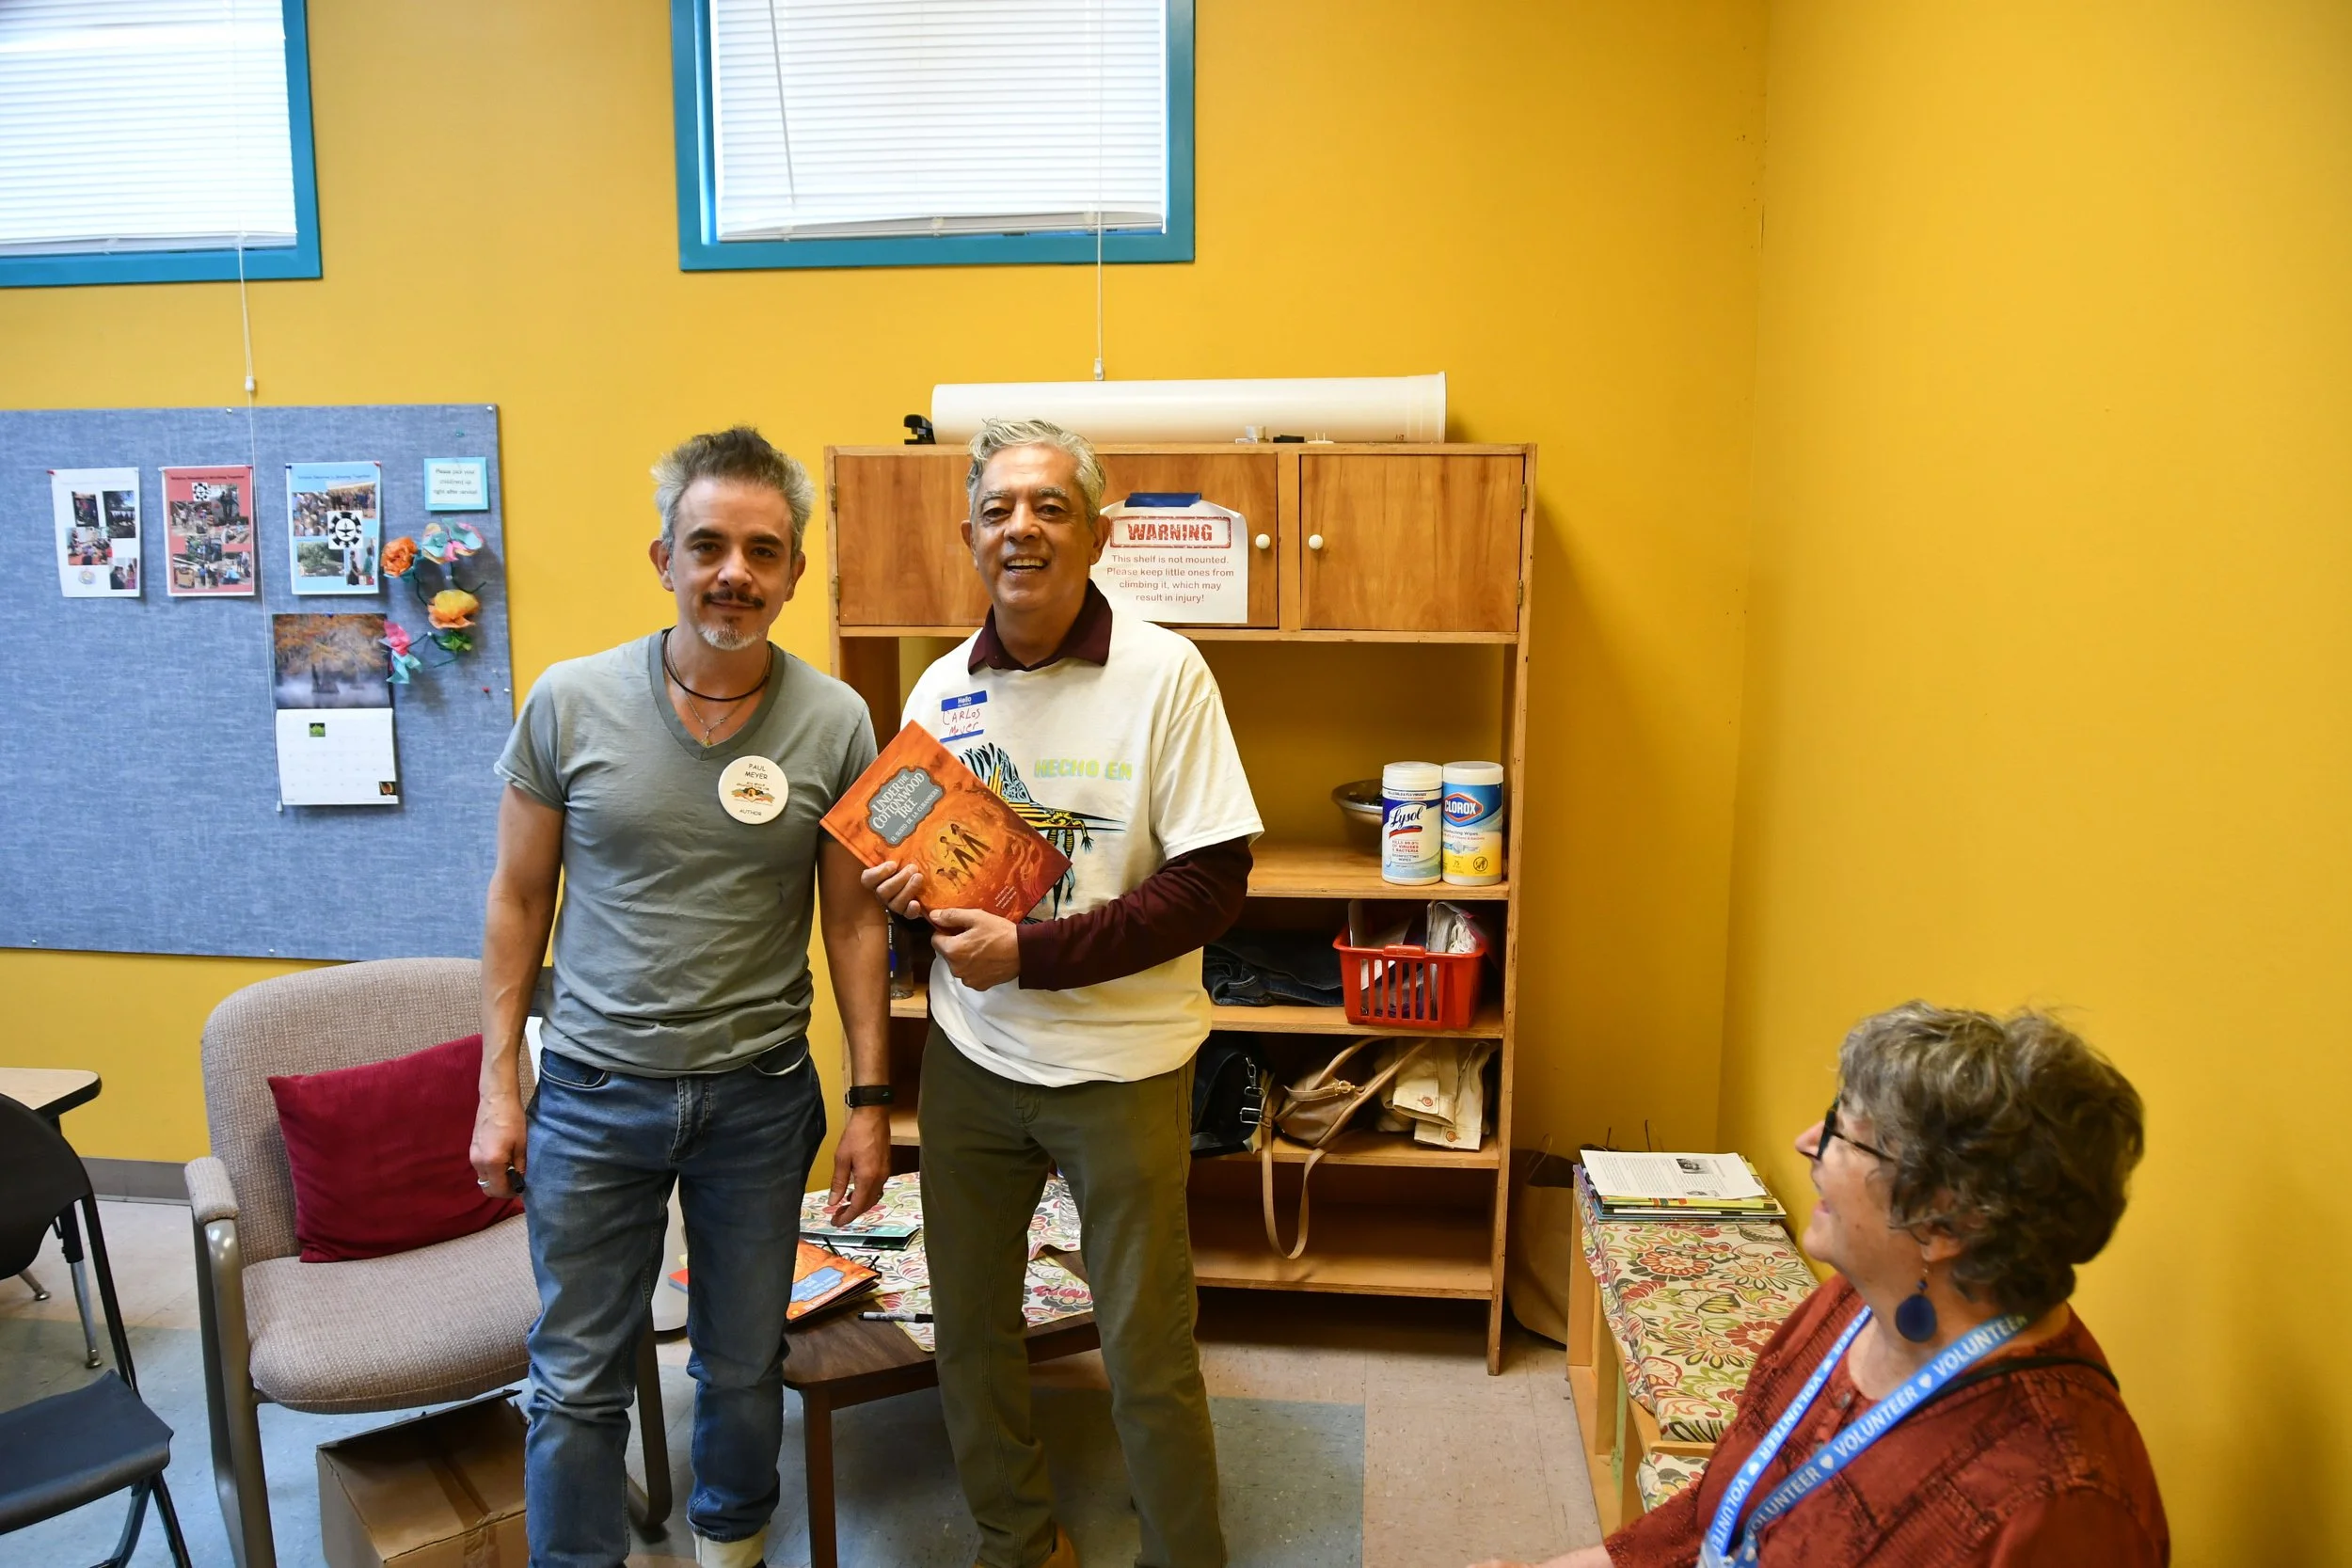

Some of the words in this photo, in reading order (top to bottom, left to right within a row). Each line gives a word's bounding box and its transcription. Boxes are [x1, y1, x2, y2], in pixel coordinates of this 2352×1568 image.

[1127, 523, 1213, 541] WARNING
[1112, 554, 1131, 563] This
[1133, 555, 1156, 563] shelf
[1185, 555, 1229, 564] mounted.
[1107, 568, 1138, 576] Please
[1140, 568, 1163, 578] keep
[1165, 568, 1185, 577] little
[1213, 568, 1234, 577] from
[1119, 581, 1159, 591] climbing
[1161, 581, 1170, 591] it,
[1172, 581, 1200, 589] which
[1202, 582, 1221, 592] may
[1136, 594, 1163, 602] result
[1176, 594, 1205, 604] injury!
[744, 771, 768, 780] MEYER
[748, 763, 767, 772] PAUL
[1033, 758, 1100, 778] HECHO
[1104, 760, 1133, 781] EN
[872, 782, 904, 813] UNDER
[872, 772, 925, 829] COTTONWOOD
[894, 797, 918, 819] TREE
[1444, 800, 1477, 815] CLOROX
[1390, 806, 1423, 828] Lysol
[1759, 1376, 1822, 1460] VOLUNTEER
[1833, 1385, 1919, 1457] VOLUNTEER
[1748, 1466, 1822, 1540] VOLUNTEER
[1712, 1478, 1750, 1554] VOLUNTE
